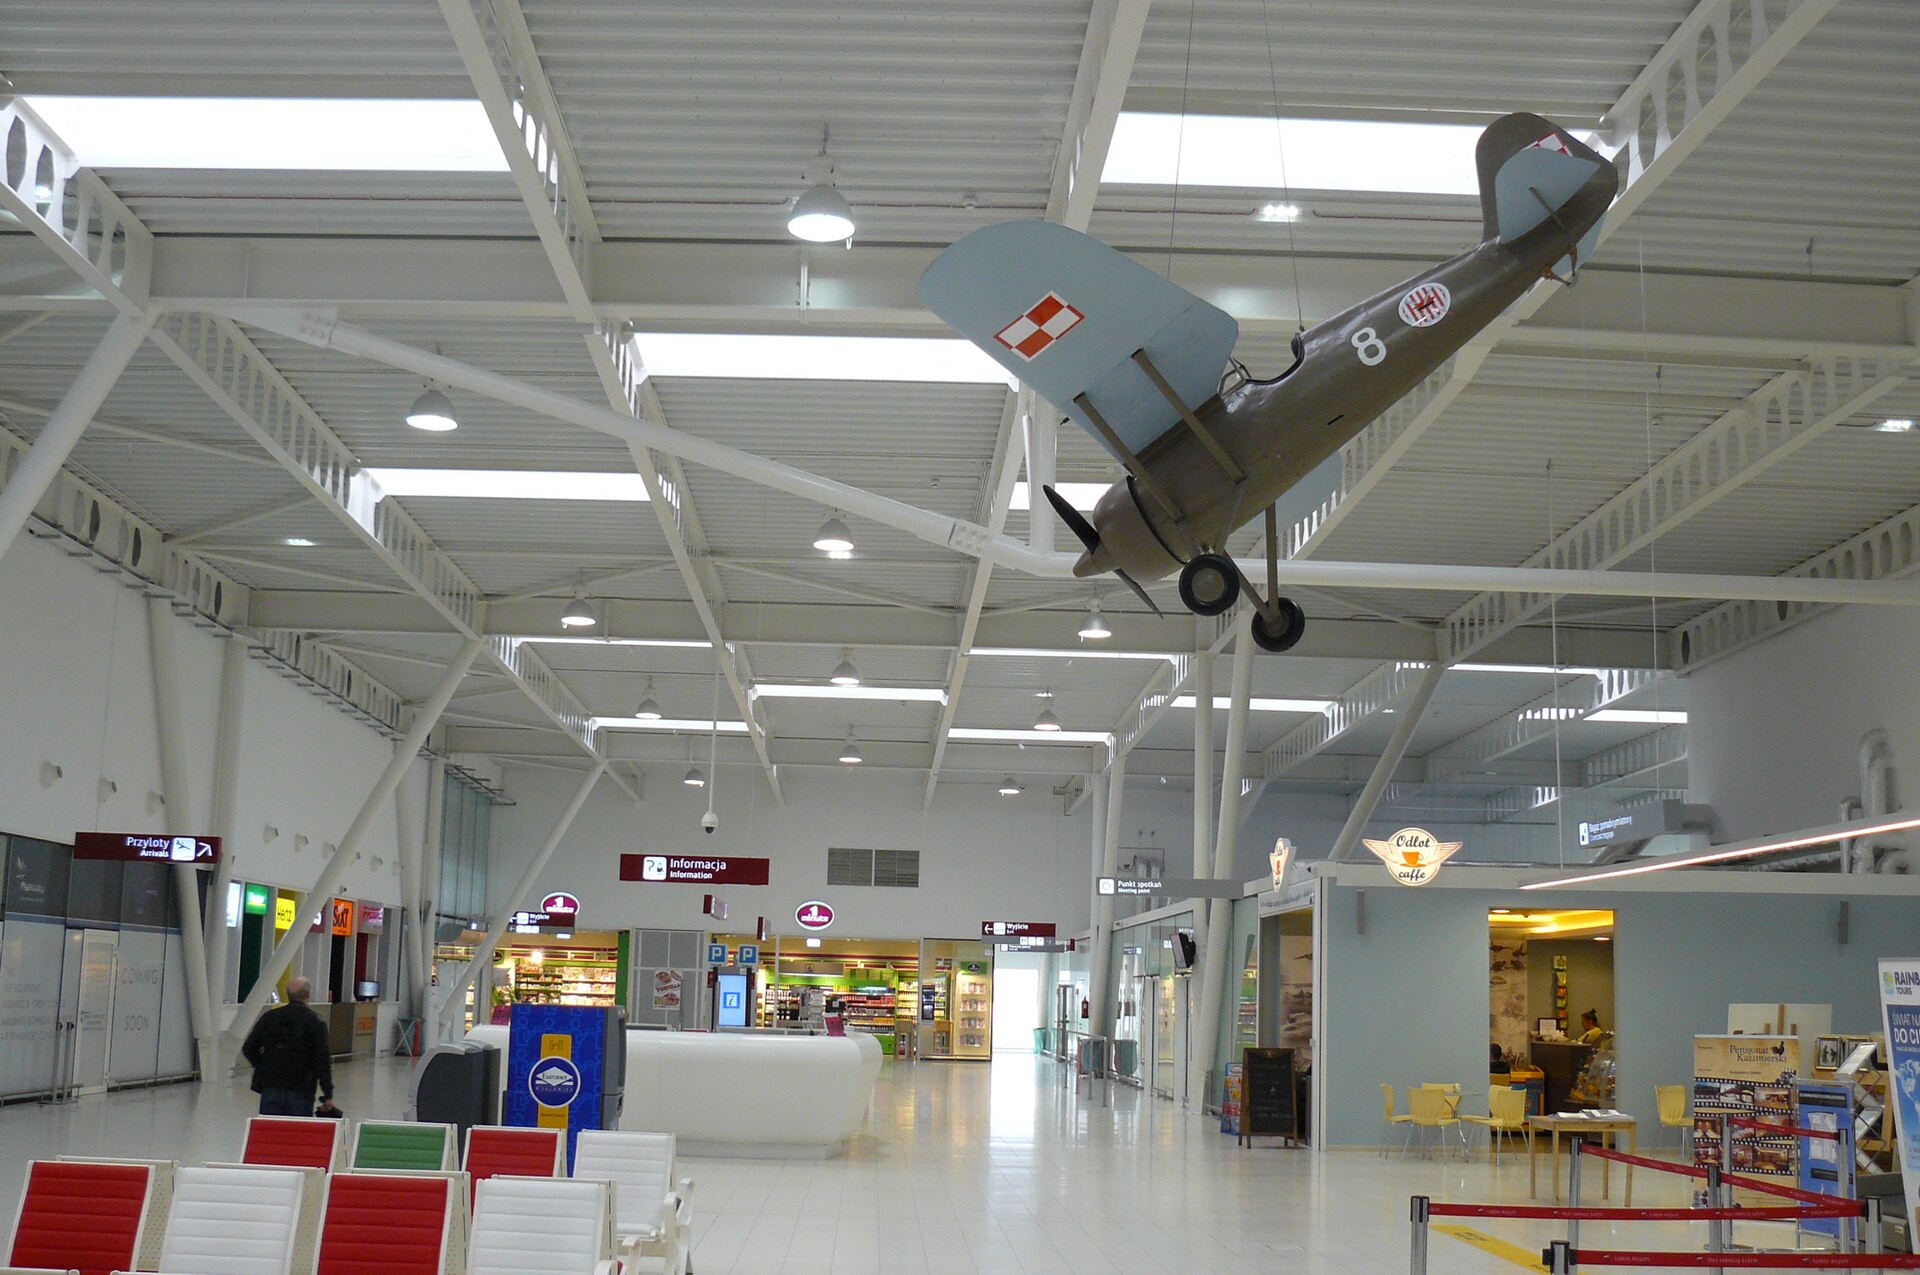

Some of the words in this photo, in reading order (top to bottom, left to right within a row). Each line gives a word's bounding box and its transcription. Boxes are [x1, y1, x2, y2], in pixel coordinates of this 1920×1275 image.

[1351, 327, 1387, 366] 8
[126, 837, 170, 849] Przyloty
[1396, 835, 1430, 848] Odlot
[670, 858, 727, 871] Informacja
[670, 870, 713, 879] Information
[1398, 867, 1426, 880] caffe
[1137, 881, 1162, 889] spotkań
[554, 896, 564, 907] 1
[277, 905, 292, 923] Hertz
[809, 905, 819, 916] 1
[801, 914, 829, 923] minute
[711, 946, 722, 960] P
[743, 947, 753, 961] P
[121, 968, 158, 985] COMING
[656, 982, 681, 992] TORTILLA
[1896, 987, 1913, 995] TOURS
[124, 1014, 150, 1031] SOON
[1894, 1028, 1908, 1044] DO
[1729, 1045, 1769, 1055] Pensjonat
[1737, 1053, 1787, 1063] Kazimierski
